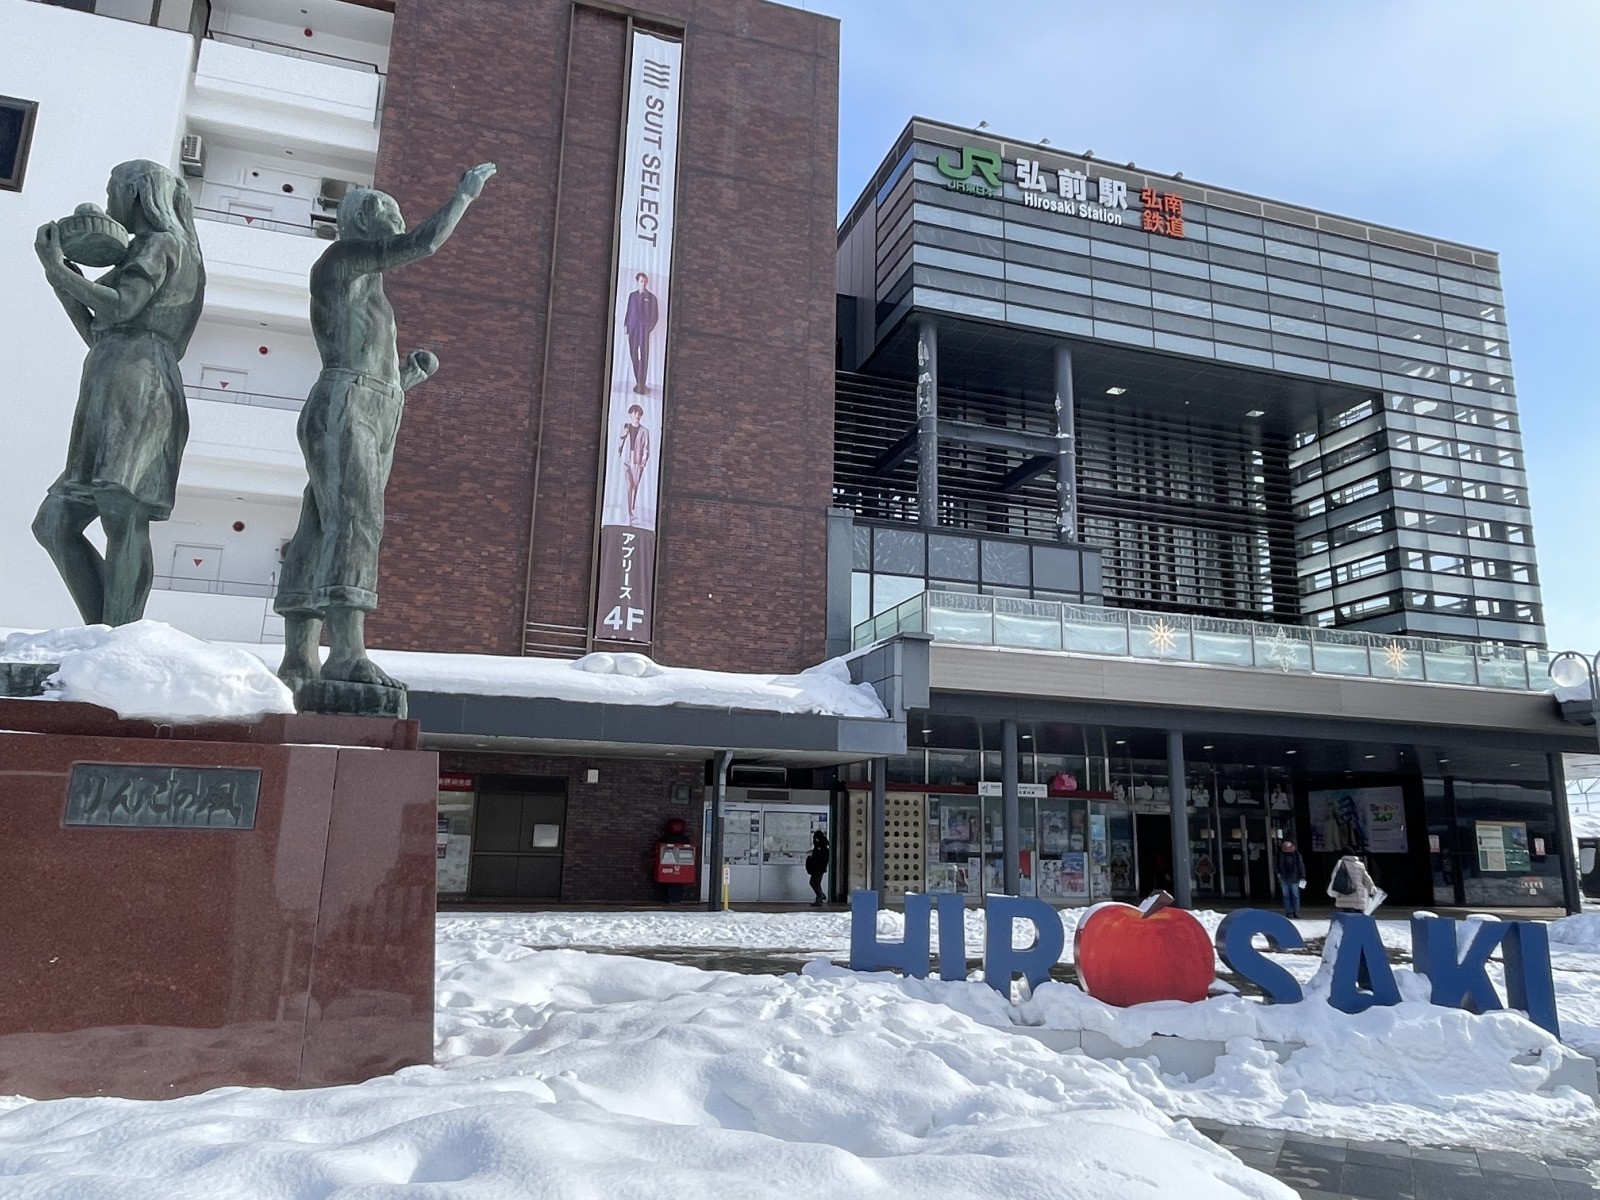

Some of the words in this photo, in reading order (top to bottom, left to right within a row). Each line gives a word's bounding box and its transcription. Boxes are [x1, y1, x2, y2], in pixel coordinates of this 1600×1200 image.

[643, 95, 664, 150] SUIT
[938, 146, 1002, 187] JR
[1016, 158, 1128, 209] 弘前駅
[639, 154, 661, 247] SELECT
[1024, 192, 1075, 215] Hirosaki
[1079, 204, 1122, 225] Station
[1141, 187, 1184, 214] 弘南
[1142, 210, 1185, 238] 鉄道
[603, 605, 645, 631] 4F
